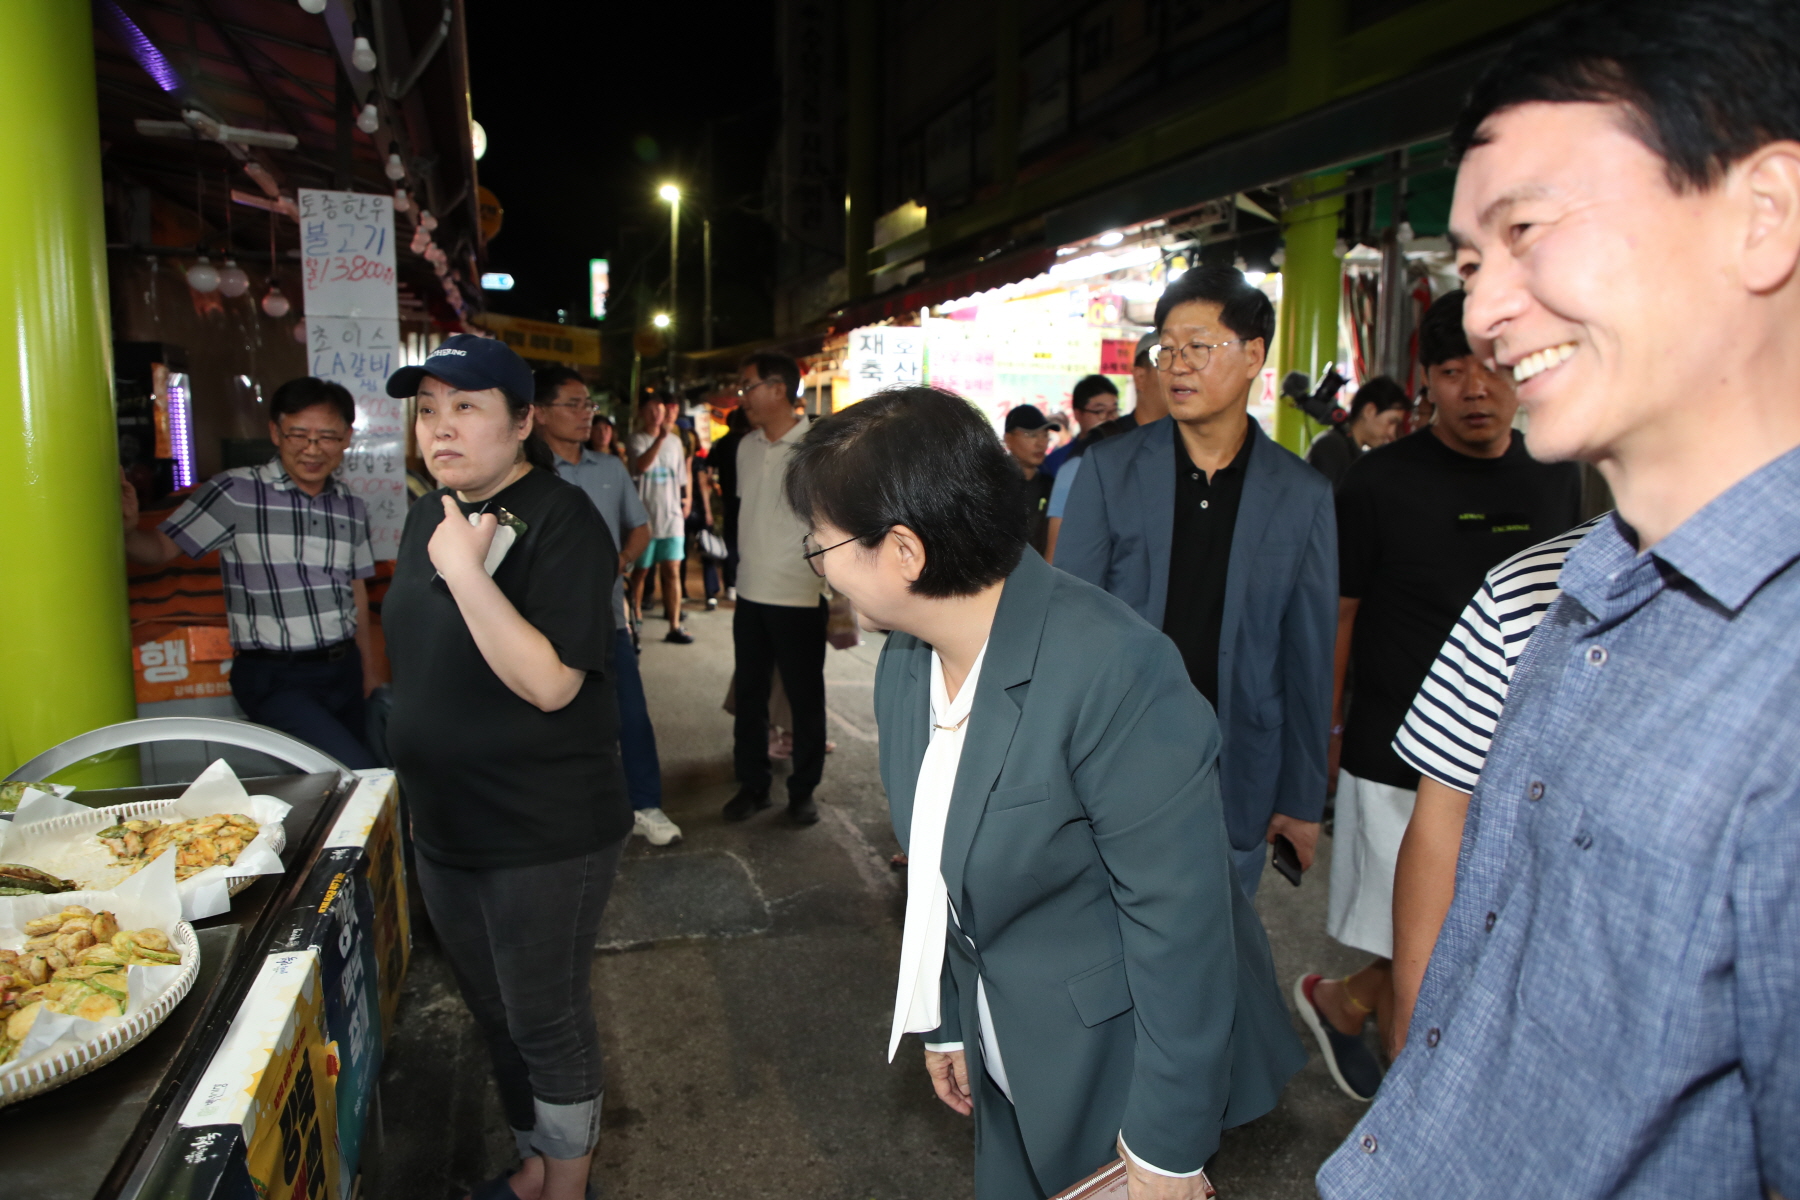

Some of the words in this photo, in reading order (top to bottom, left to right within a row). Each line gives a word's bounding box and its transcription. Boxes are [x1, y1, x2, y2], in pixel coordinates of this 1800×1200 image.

[302, 193, 385, 222] 토종한우
[305, 222, 386, 257] 불고기
[312, 325, 392, 353] 초이스
[313, 352, 391, 379] LA갈비
